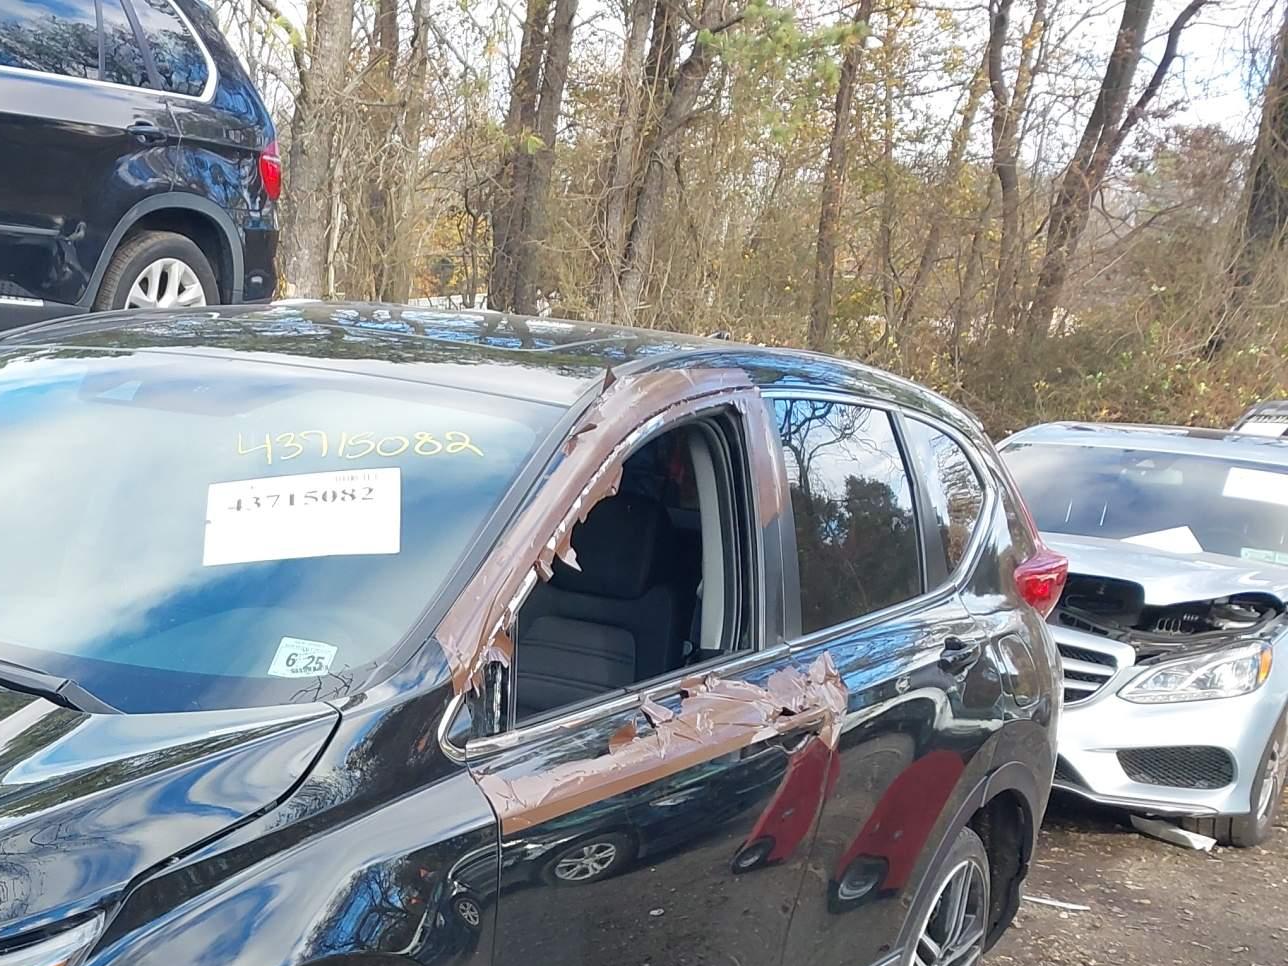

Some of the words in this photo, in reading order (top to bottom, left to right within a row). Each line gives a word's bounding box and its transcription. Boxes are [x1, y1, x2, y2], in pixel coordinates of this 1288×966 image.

[236, 430, 484, 465] 43715082
[228, 486, 376, 512] 43715082
[286, 652, 298, 667] 6
[303, 654, 325, 671] 25
